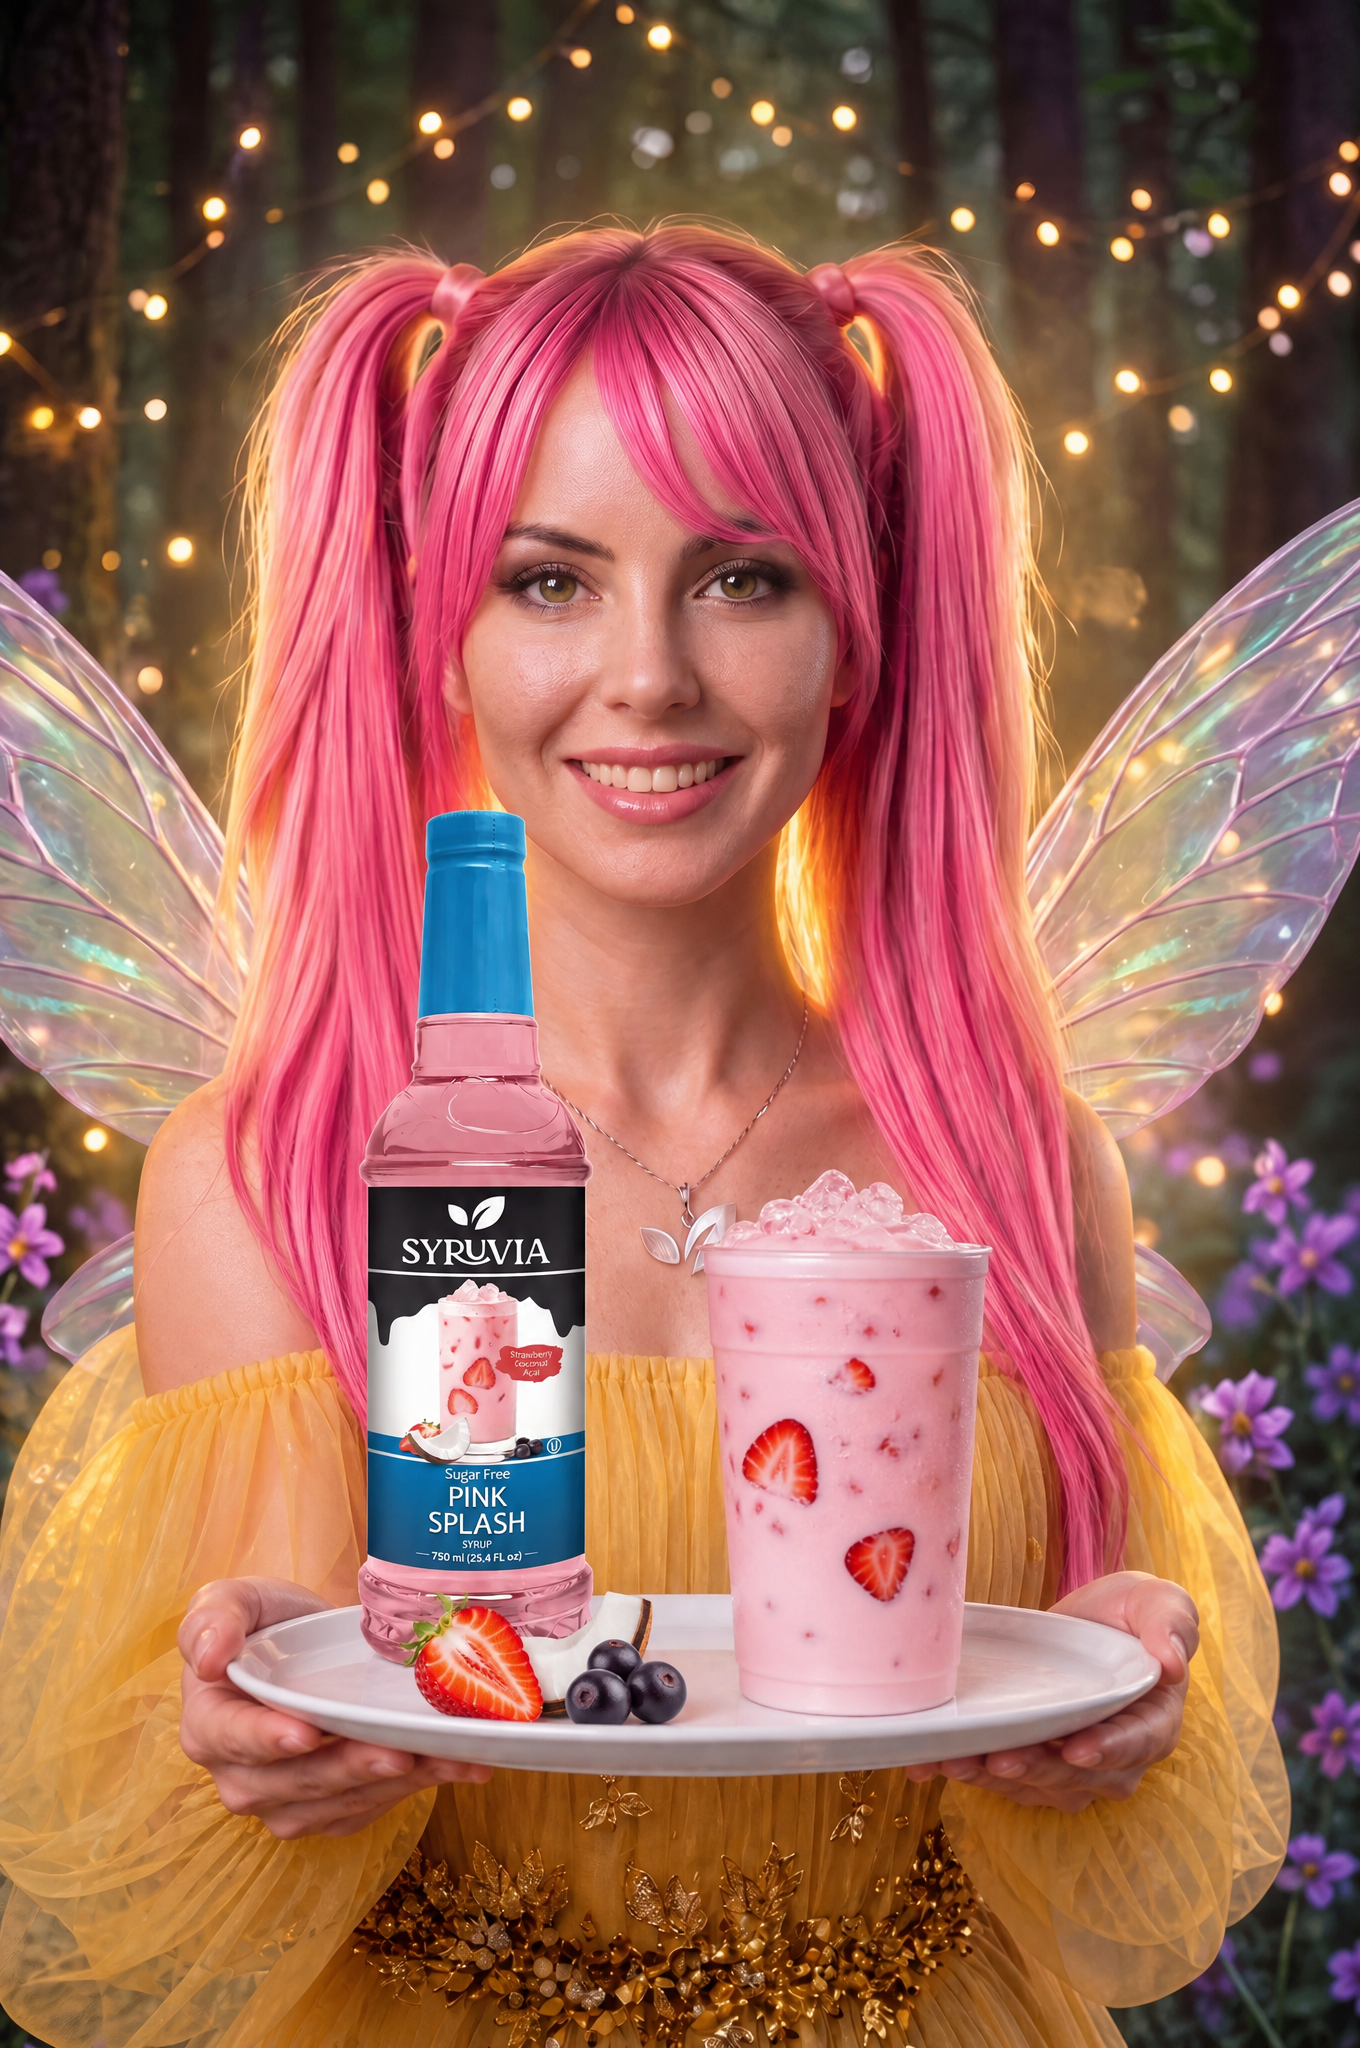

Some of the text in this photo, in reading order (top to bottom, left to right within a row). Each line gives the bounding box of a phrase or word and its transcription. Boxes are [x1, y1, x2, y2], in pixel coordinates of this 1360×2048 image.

[402, 1238, 550, 1265] SYRUVIA
[510, 1350, 553, 1359] Strawberry
[445, 1468, 511, 1483] Sugar Free
[449, 1486, 507, 1508] PINK
[428, 1511, 525, 1535] SPLASH
[462, 1540, 492, 1549] SYRUP
[432, 1551, 450, 1562] 750
[452, 1552, 465, 1562] ml
[467, 1553, 491, 1564] (25.4
[507, 1551, 522, 1562] oz)
